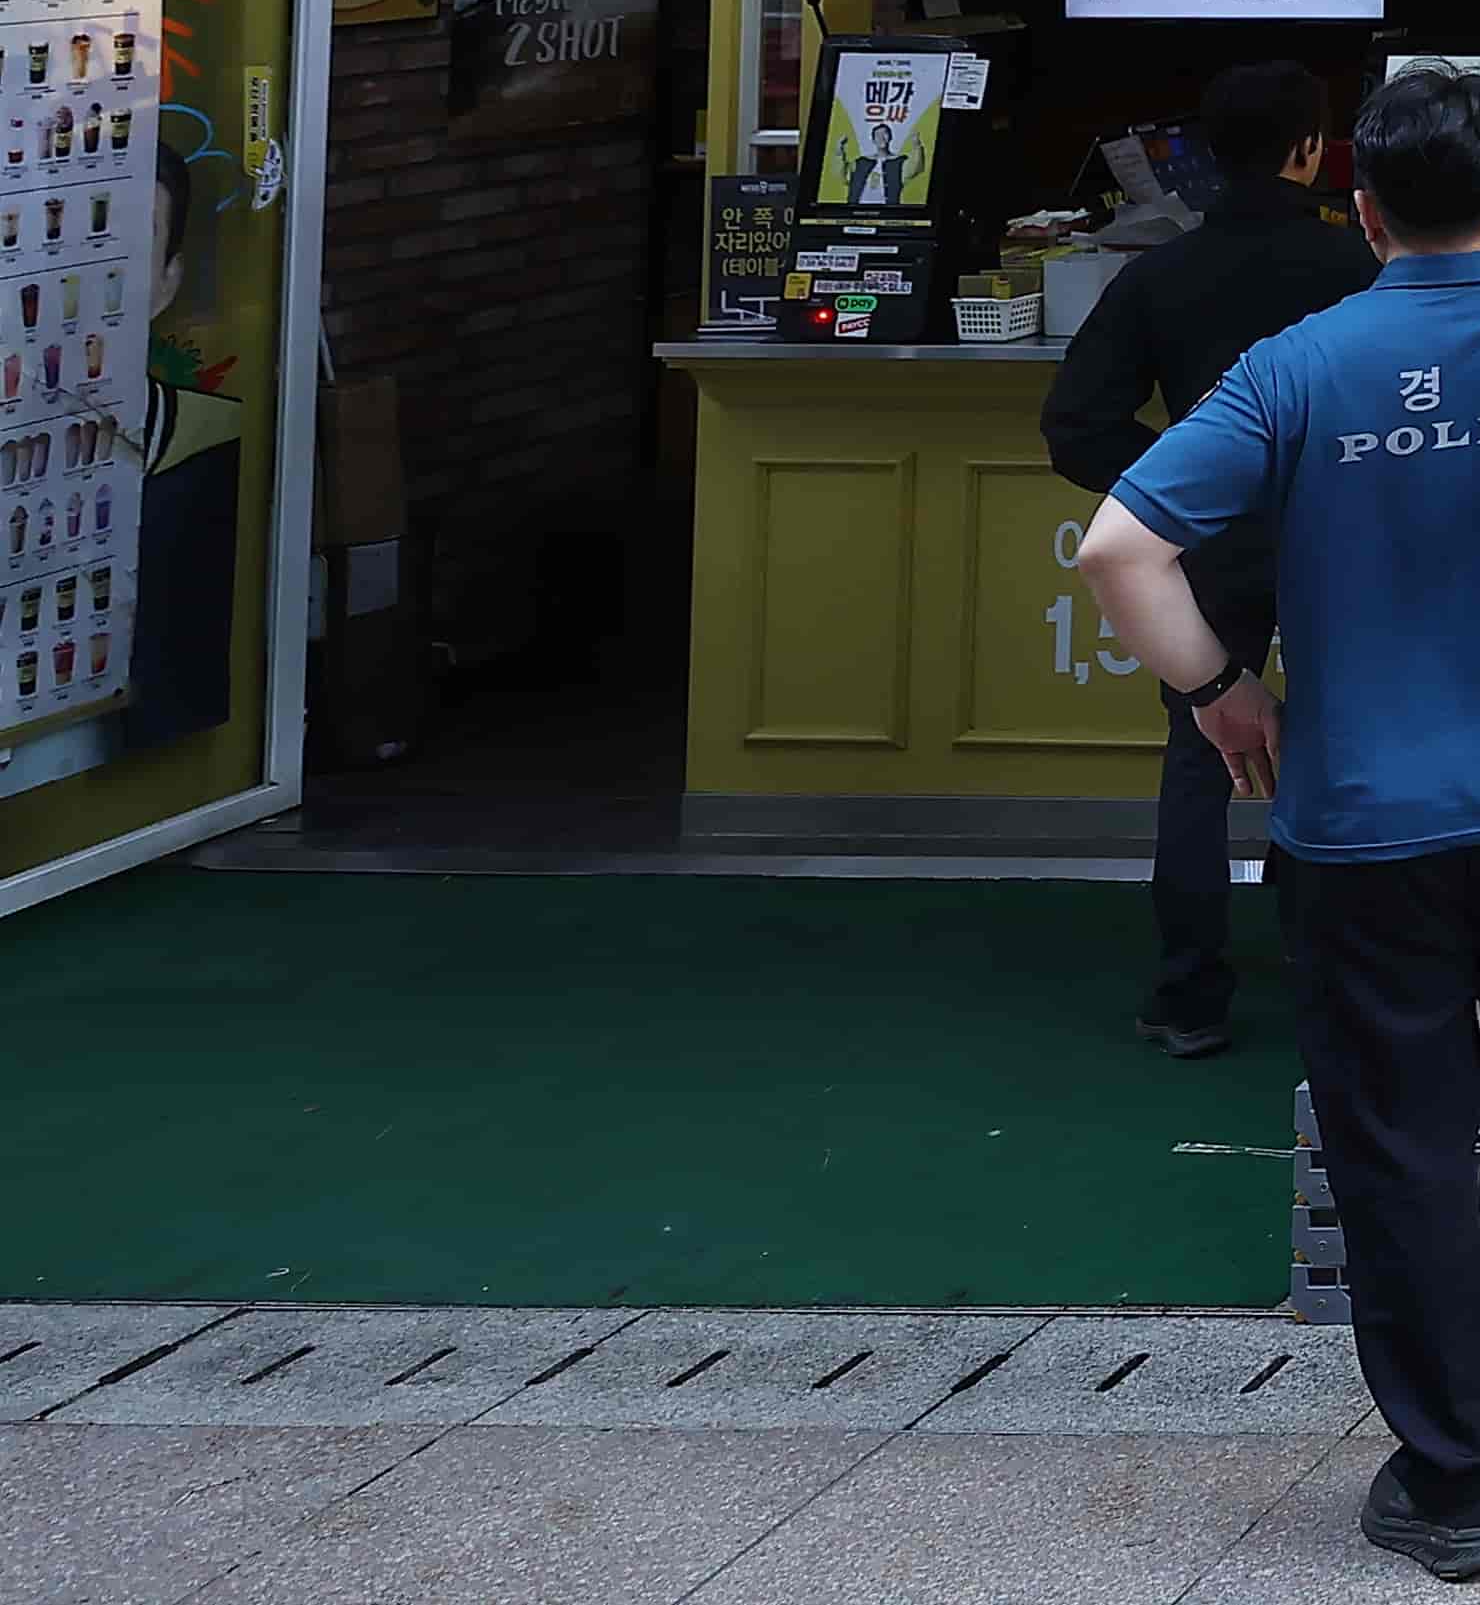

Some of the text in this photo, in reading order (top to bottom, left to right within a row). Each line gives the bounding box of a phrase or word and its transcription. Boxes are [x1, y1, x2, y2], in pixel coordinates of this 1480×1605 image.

[504, 15, 625, 67] 2 SHOT
[866, 81, 914, 104] 메가
